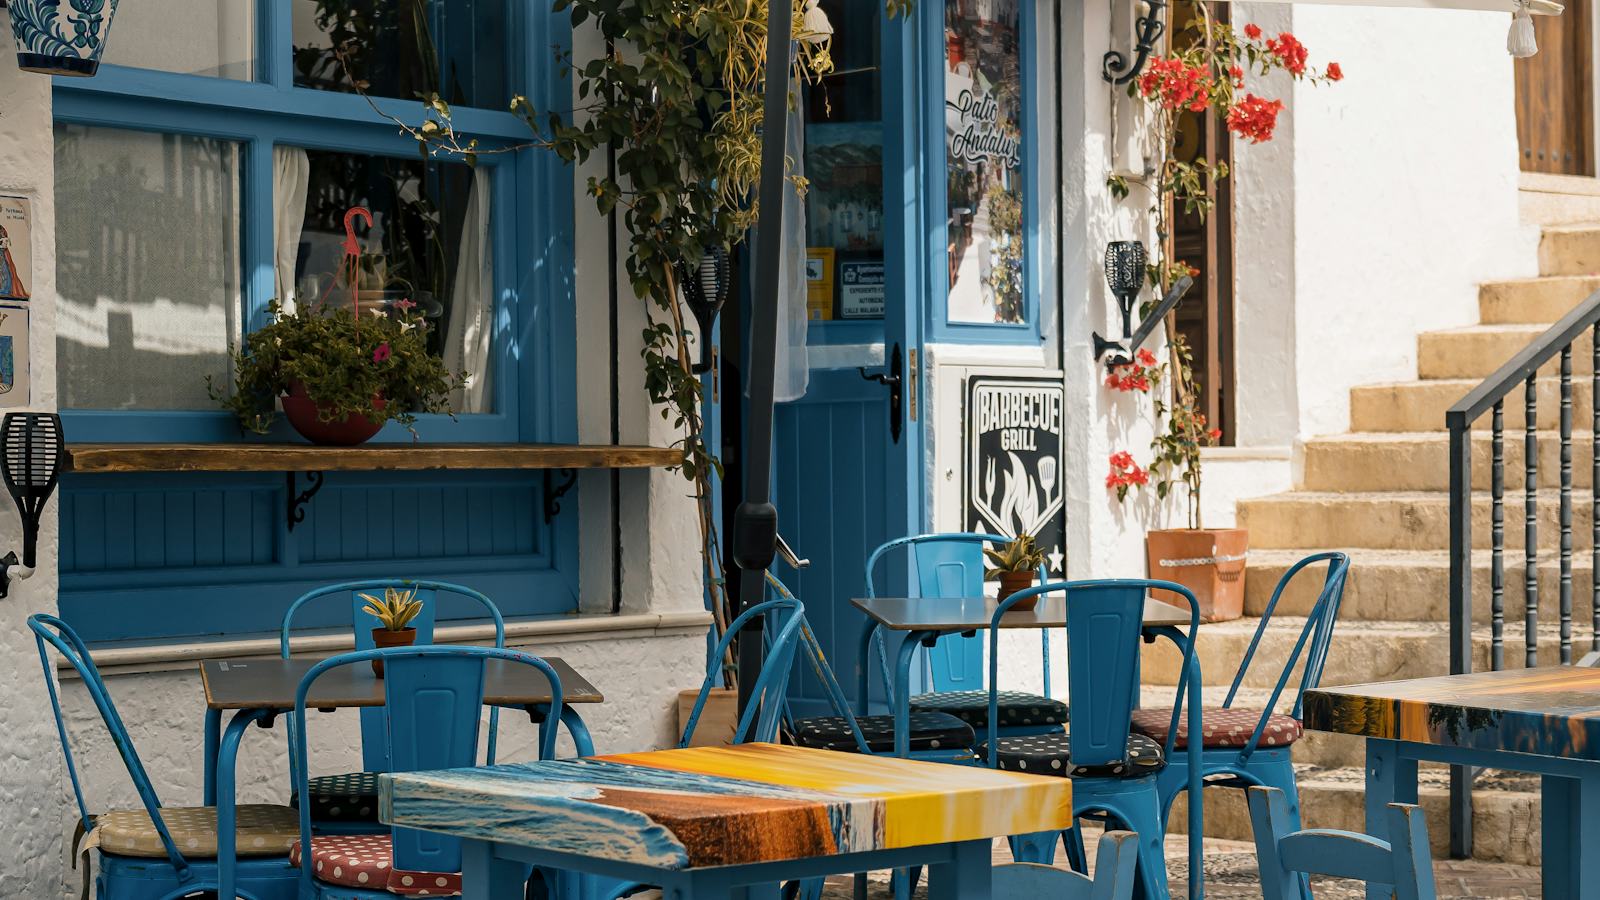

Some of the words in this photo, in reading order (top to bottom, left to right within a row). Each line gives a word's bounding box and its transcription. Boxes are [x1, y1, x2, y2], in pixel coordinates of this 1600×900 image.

[946, 89, 998, 124] Patio
[952, 123, 1020, 167] Andaluz
[980, 391, 1060, 435] BARBECUE
[1001, 428, 1038, 452] GRILL
